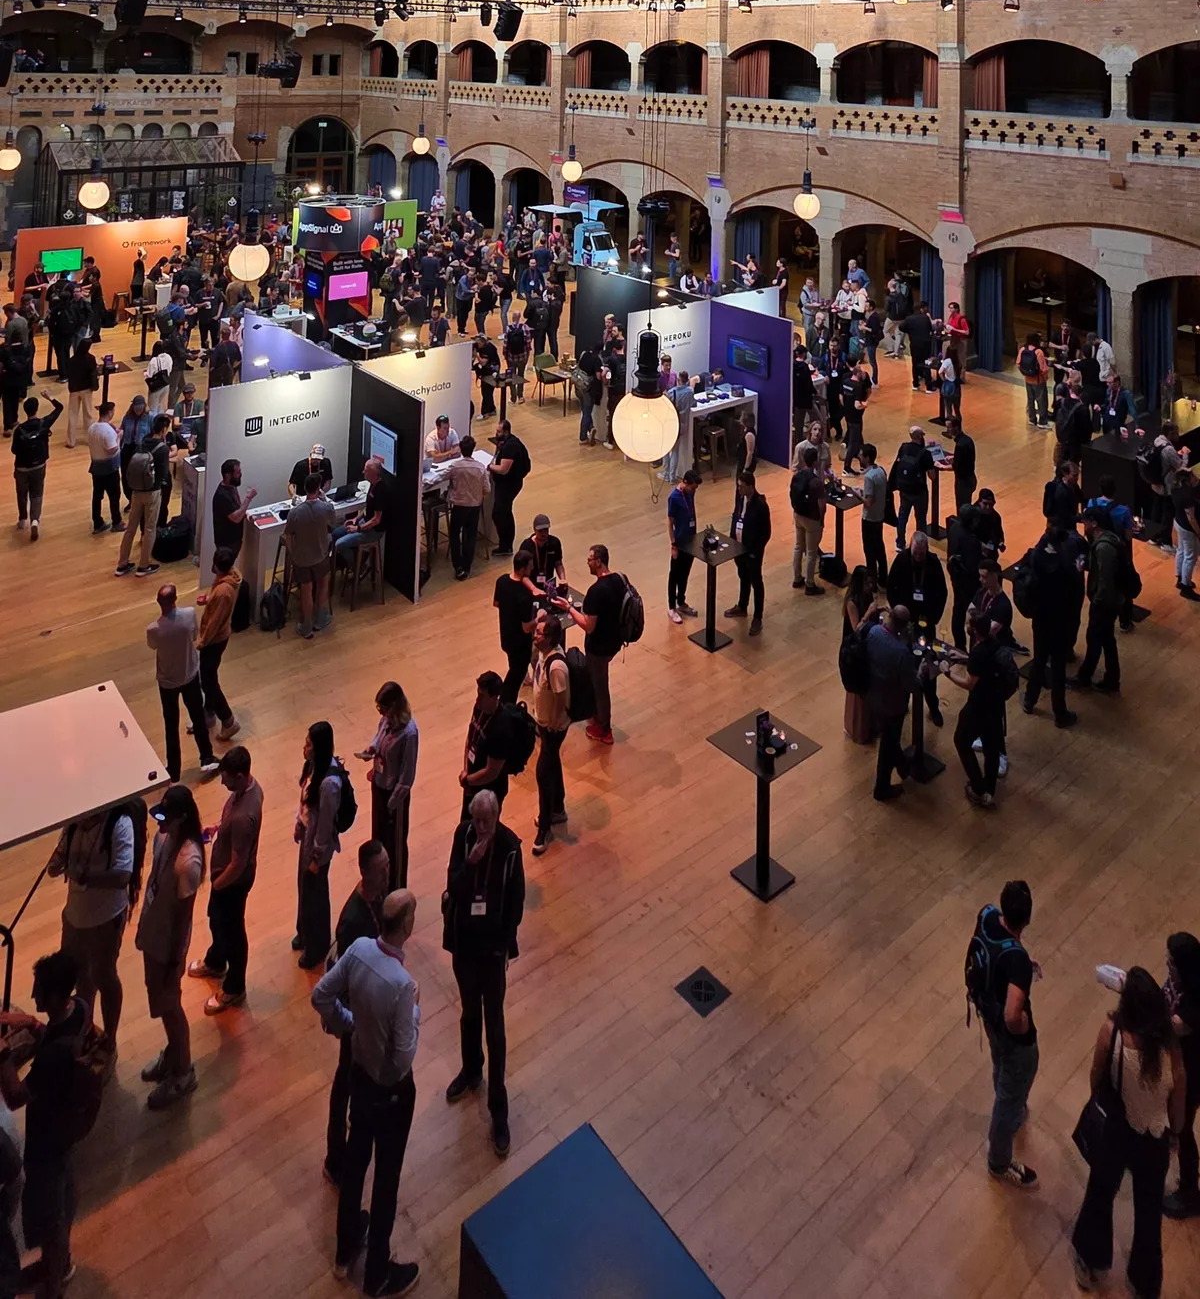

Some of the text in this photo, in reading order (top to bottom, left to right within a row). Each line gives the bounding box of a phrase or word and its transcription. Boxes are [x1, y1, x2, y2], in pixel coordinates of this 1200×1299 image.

[299, 222, 329, 234] AppSignal
[131, 238, 171, 247] framework
[663, 331, 692, 342] HEROKU
[408, 382, 451, 396] nchydata
[269, 410, 320, 427] INTERCOM
